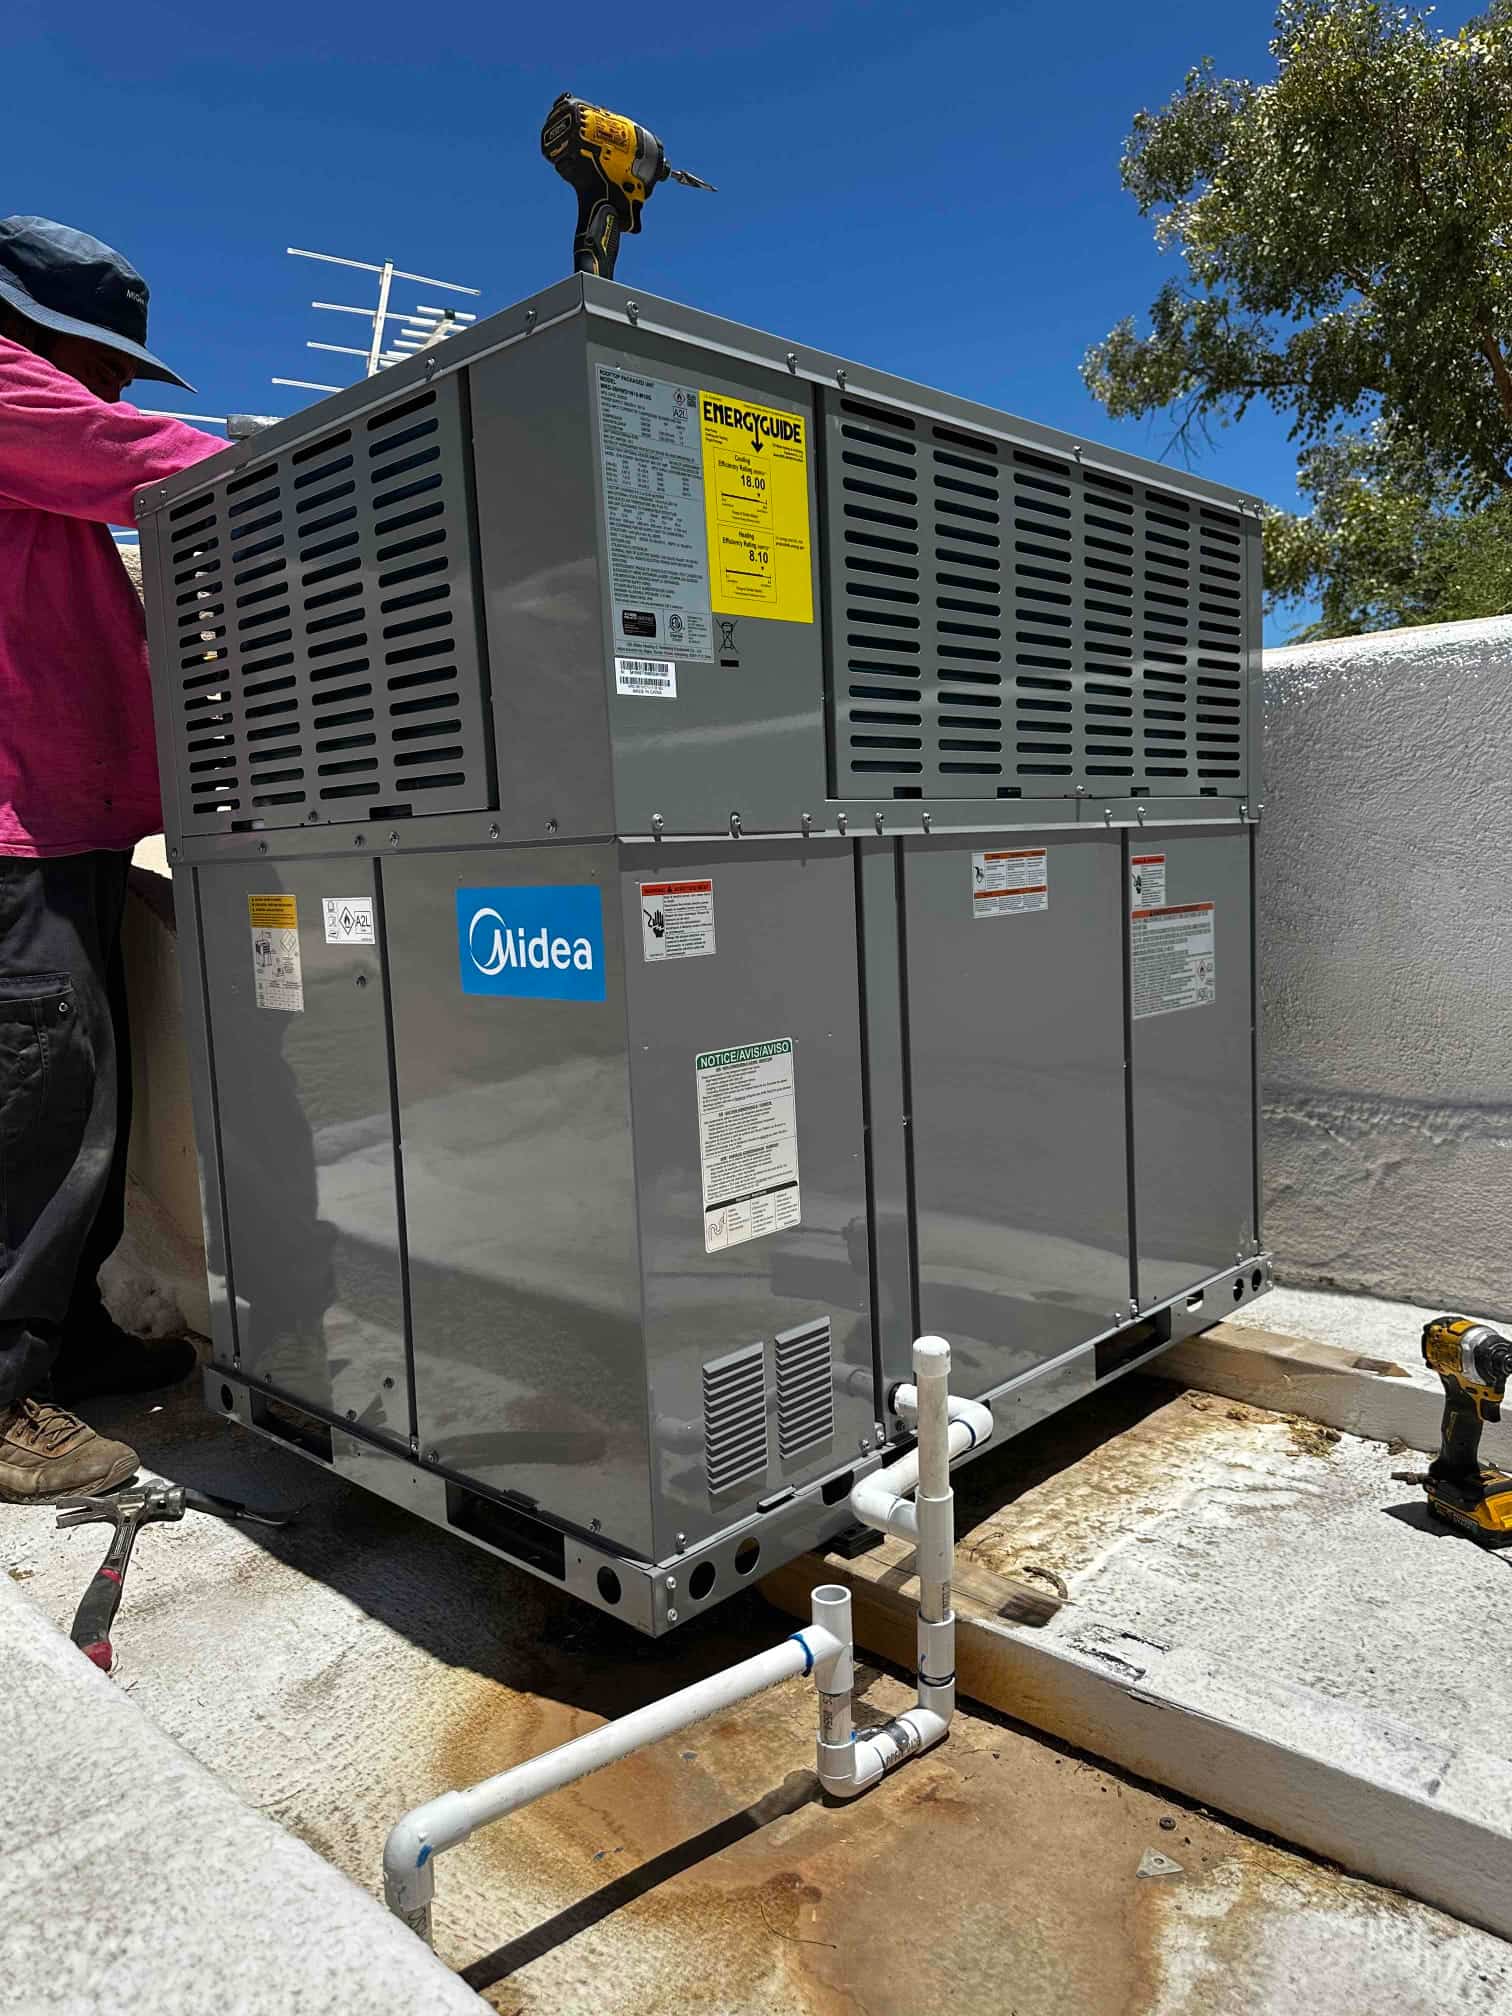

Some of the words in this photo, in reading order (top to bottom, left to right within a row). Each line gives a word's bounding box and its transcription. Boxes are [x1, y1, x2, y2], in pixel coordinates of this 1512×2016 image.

[703, 400, 802, 444] ENERGYGUIDE
[741, 474, 766, 490] 18.00
[749, 550, 769, 564] 8.10
[355, 914, 372, 928] A2L
[470, 908, 594, 976] Midea
[700, 1041, 789, 1068] NOTICE/AVIS/AVISO
